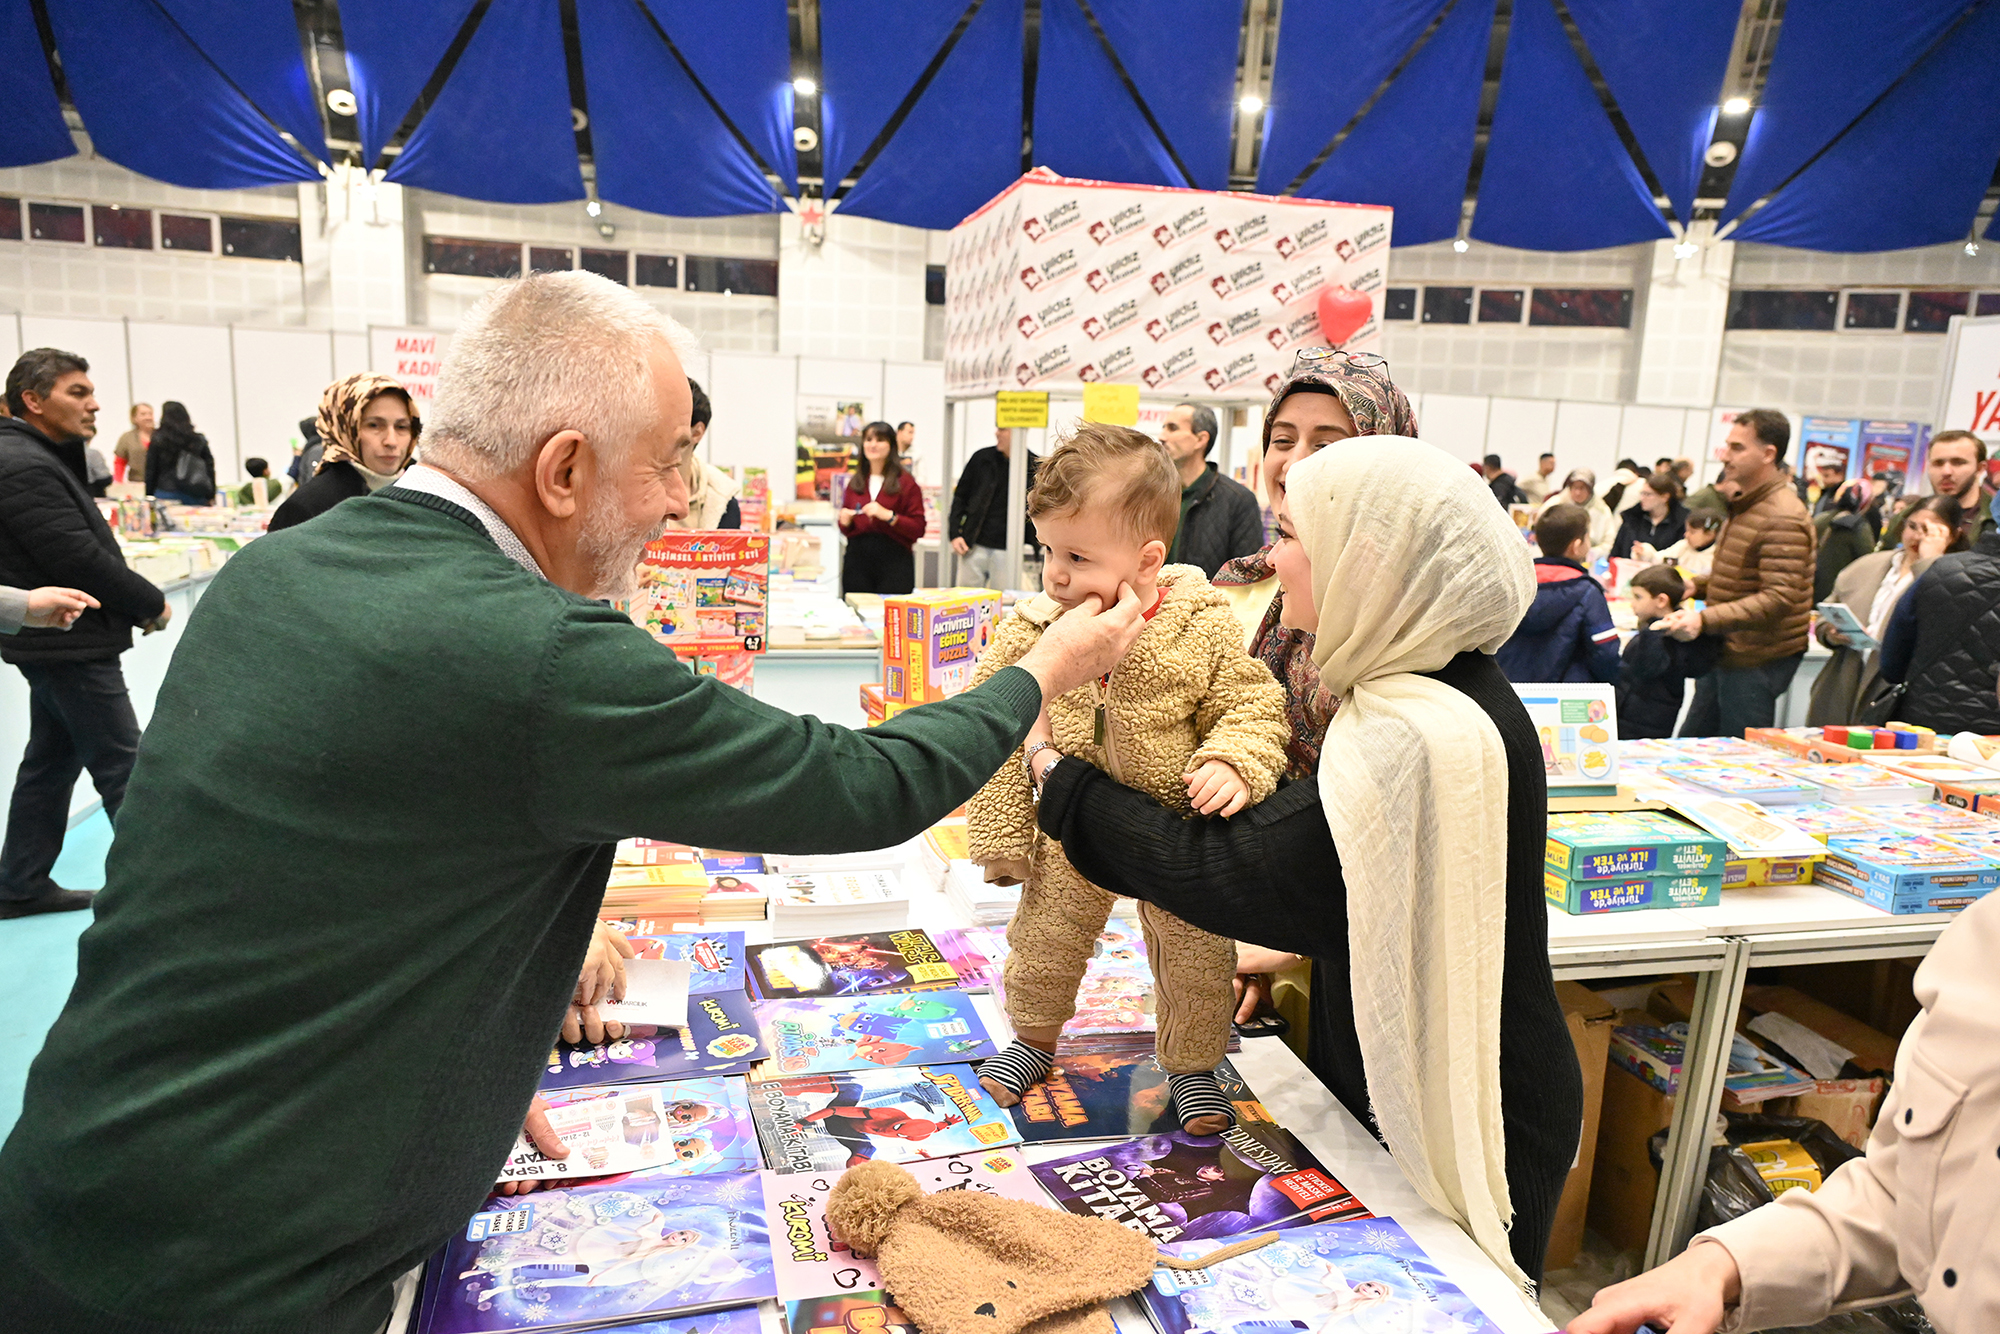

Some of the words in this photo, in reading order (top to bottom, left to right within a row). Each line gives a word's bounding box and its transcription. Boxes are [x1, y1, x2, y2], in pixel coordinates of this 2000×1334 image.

[395, 336, 436, 354] MAVİ
[680, 541, 720, 552] Adeda
[647, 550, 692, 562] ELİŞİMSEL
[739, 548, 760, 560] SETİ
[933, 615, 974, 636] AKTİVİTELİ
[940, 629, 968, 649] EĞİTİCİ
[938, 646, 969, 664] PUZZLE
[943, 671, 947, 681] 1
[948, 667, 964, 680] YAŞ
[1630, 851, 1649, 863] İLK
[1683, 845, 1703, 855] SETİ
[1593, 855, 1614, 867] TEK
[1617, 854, 1628, 862] ve
[1672, 853, 1712, 864] AKTİVİTE
[1597, 861, 1644, 875] Türkiye'de
[1678, 878, 1698, 887] SETİ
[1879, 873, 1890, 884] YAŞ
[1590, 888, 1611, 900] TEK
[1613, 887, 1625, 896] ve
[1626, 884, 1644, 895] İLK
[1668, 886, 1708, 897] AKTİVİTE
[1875, 889, 1886, 901] YAŞ
[1594, 894, 1640, 908] Türkiye'de
[889, 933, 923, 964] WARS
[905, 931, 940, 963] STAR
[1023, 1088, 1055, 1123] TABI
[1045, 1074, 1089, 1128] OYAMA
[763, 1089, 797, 1137] BOYAMA
[785, 1134, 815, 1174] KİTABI
[1219, 1124, 1299, 1175] EDNESDAY
[499, 1165, 545, 1177] ISPA
[551, 1162, 568, 1173] 8.
[1292, 1174, 1306, 1182] VE
[1300, 1181, 1327, 1198] MASKE
[1305, 1173, 1335, 1193] STICKER
[1053, 1160, 1153, 1237] KİTAB
[1081, 1157, 1186, 1245] BOYAMA
[493, 1213, 501, 1233] MASKE
[506, 1211, 514, 1233] STICKER
[516, 1210, 526, 1231] BOYAMA
